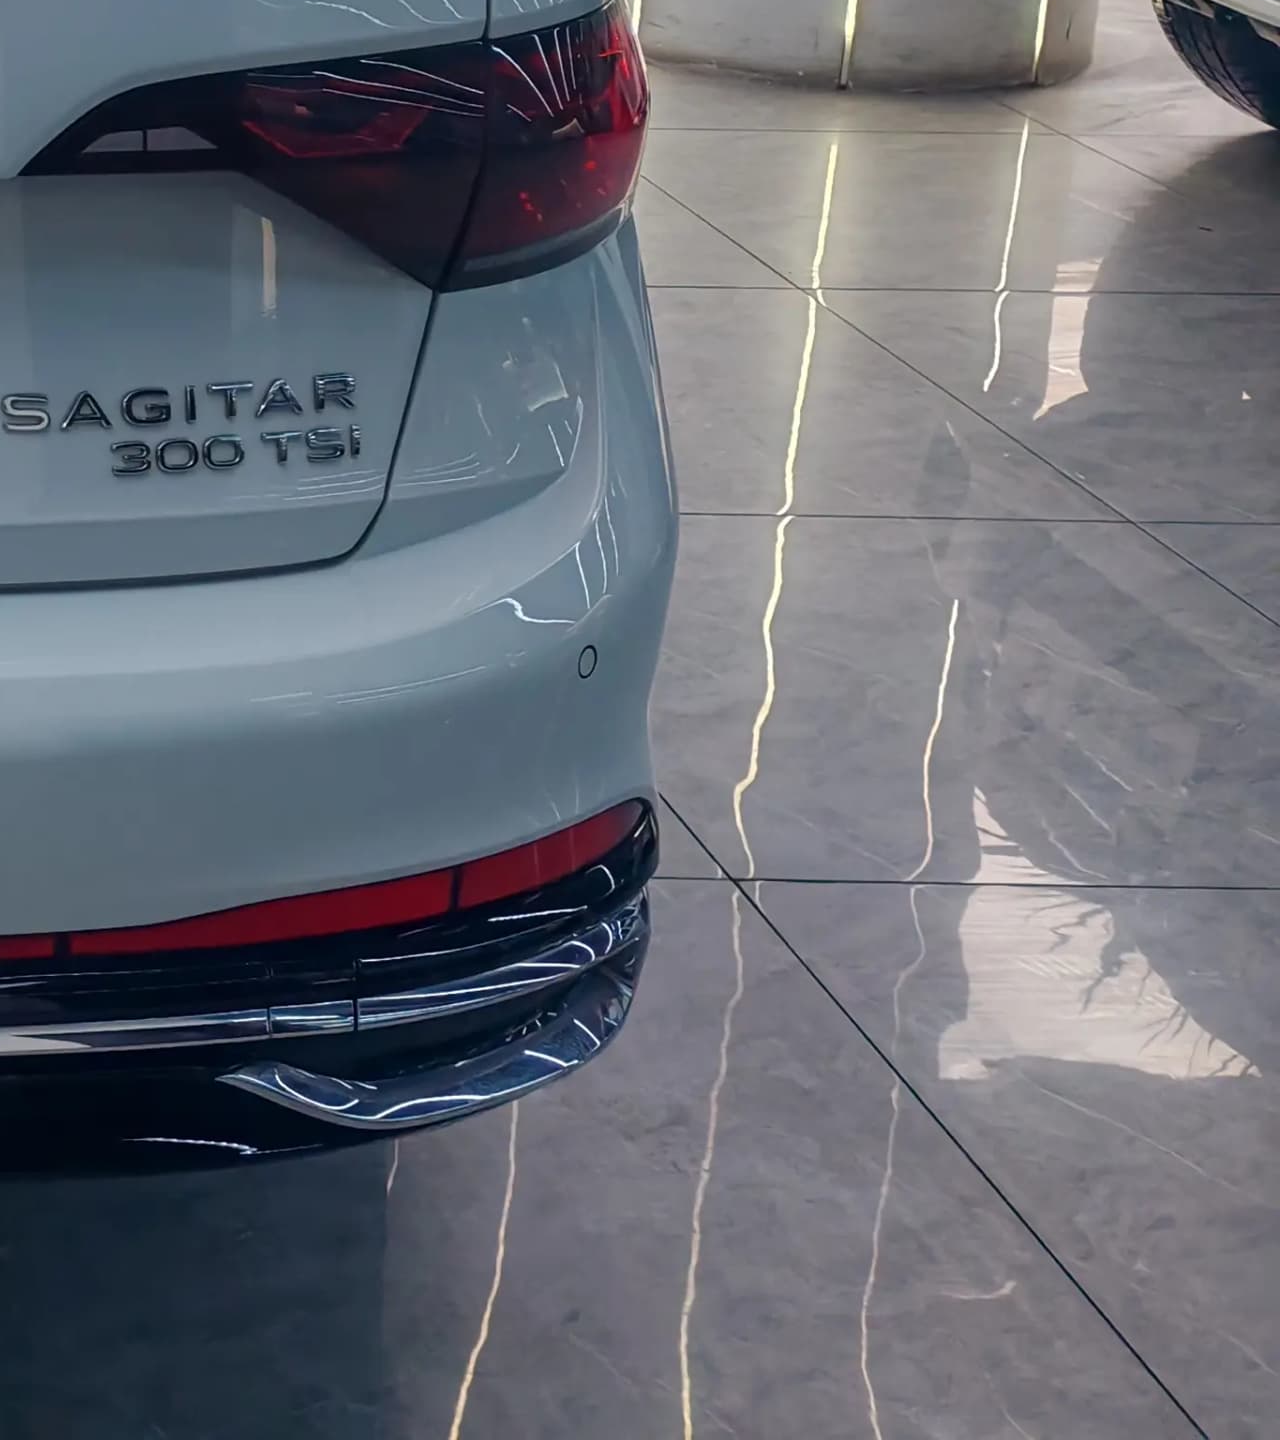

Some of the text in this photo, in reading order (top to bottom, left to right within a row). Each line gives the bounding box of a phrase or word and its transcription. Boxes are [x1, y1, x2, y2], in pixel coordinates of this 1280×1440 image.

[1, 371, 357, 433] SAGITAR
[110, 423, 361, 477] 300 TSI
